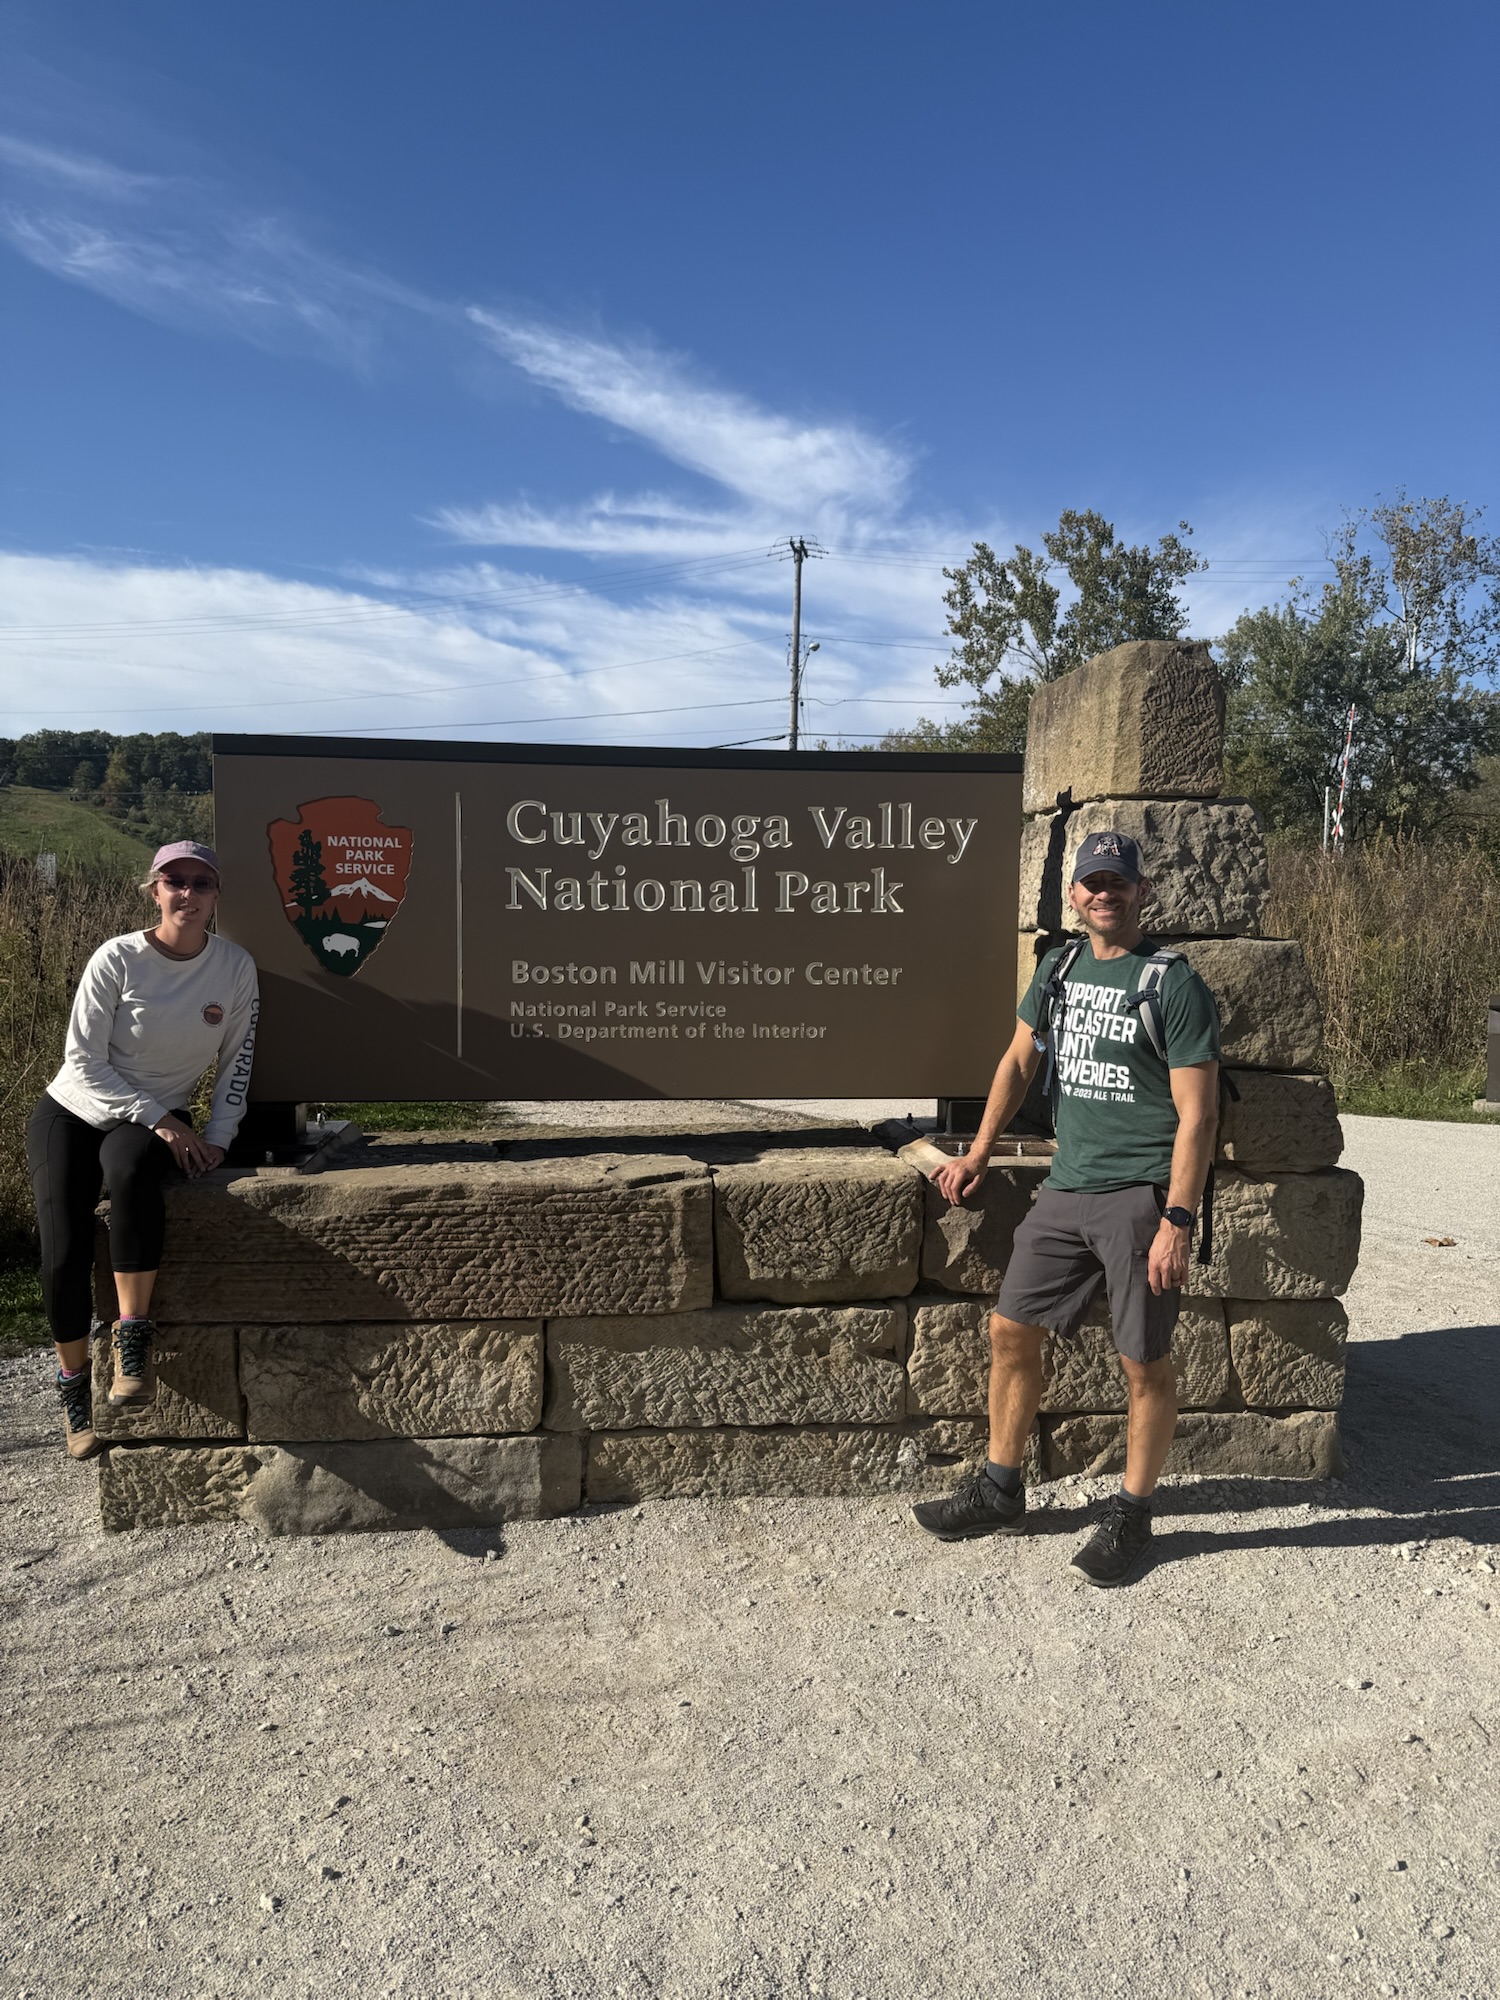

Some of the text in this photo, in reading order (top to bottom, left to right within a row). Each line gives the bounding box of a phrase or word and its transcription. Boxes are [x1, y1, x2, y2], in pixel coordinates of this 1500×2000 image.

[506, 798, 978, 864] Cuyahoga Valley
[327, 835, 402, 848] NATIONAL
[345, 850, 384, 861] PARK
[335, 863, 395, 875] SERVICE
[504, 865, 904, 913] National Park
[511, 960, 903, 985] Boston Mill Visitor Center
[510, 1001, 727, 1017] National Park Service
[510, 1022, 827, 1042] U.S. Department of the Interior
[1073, 1088, 1136, 1103] 2023 ALE TRAIL
